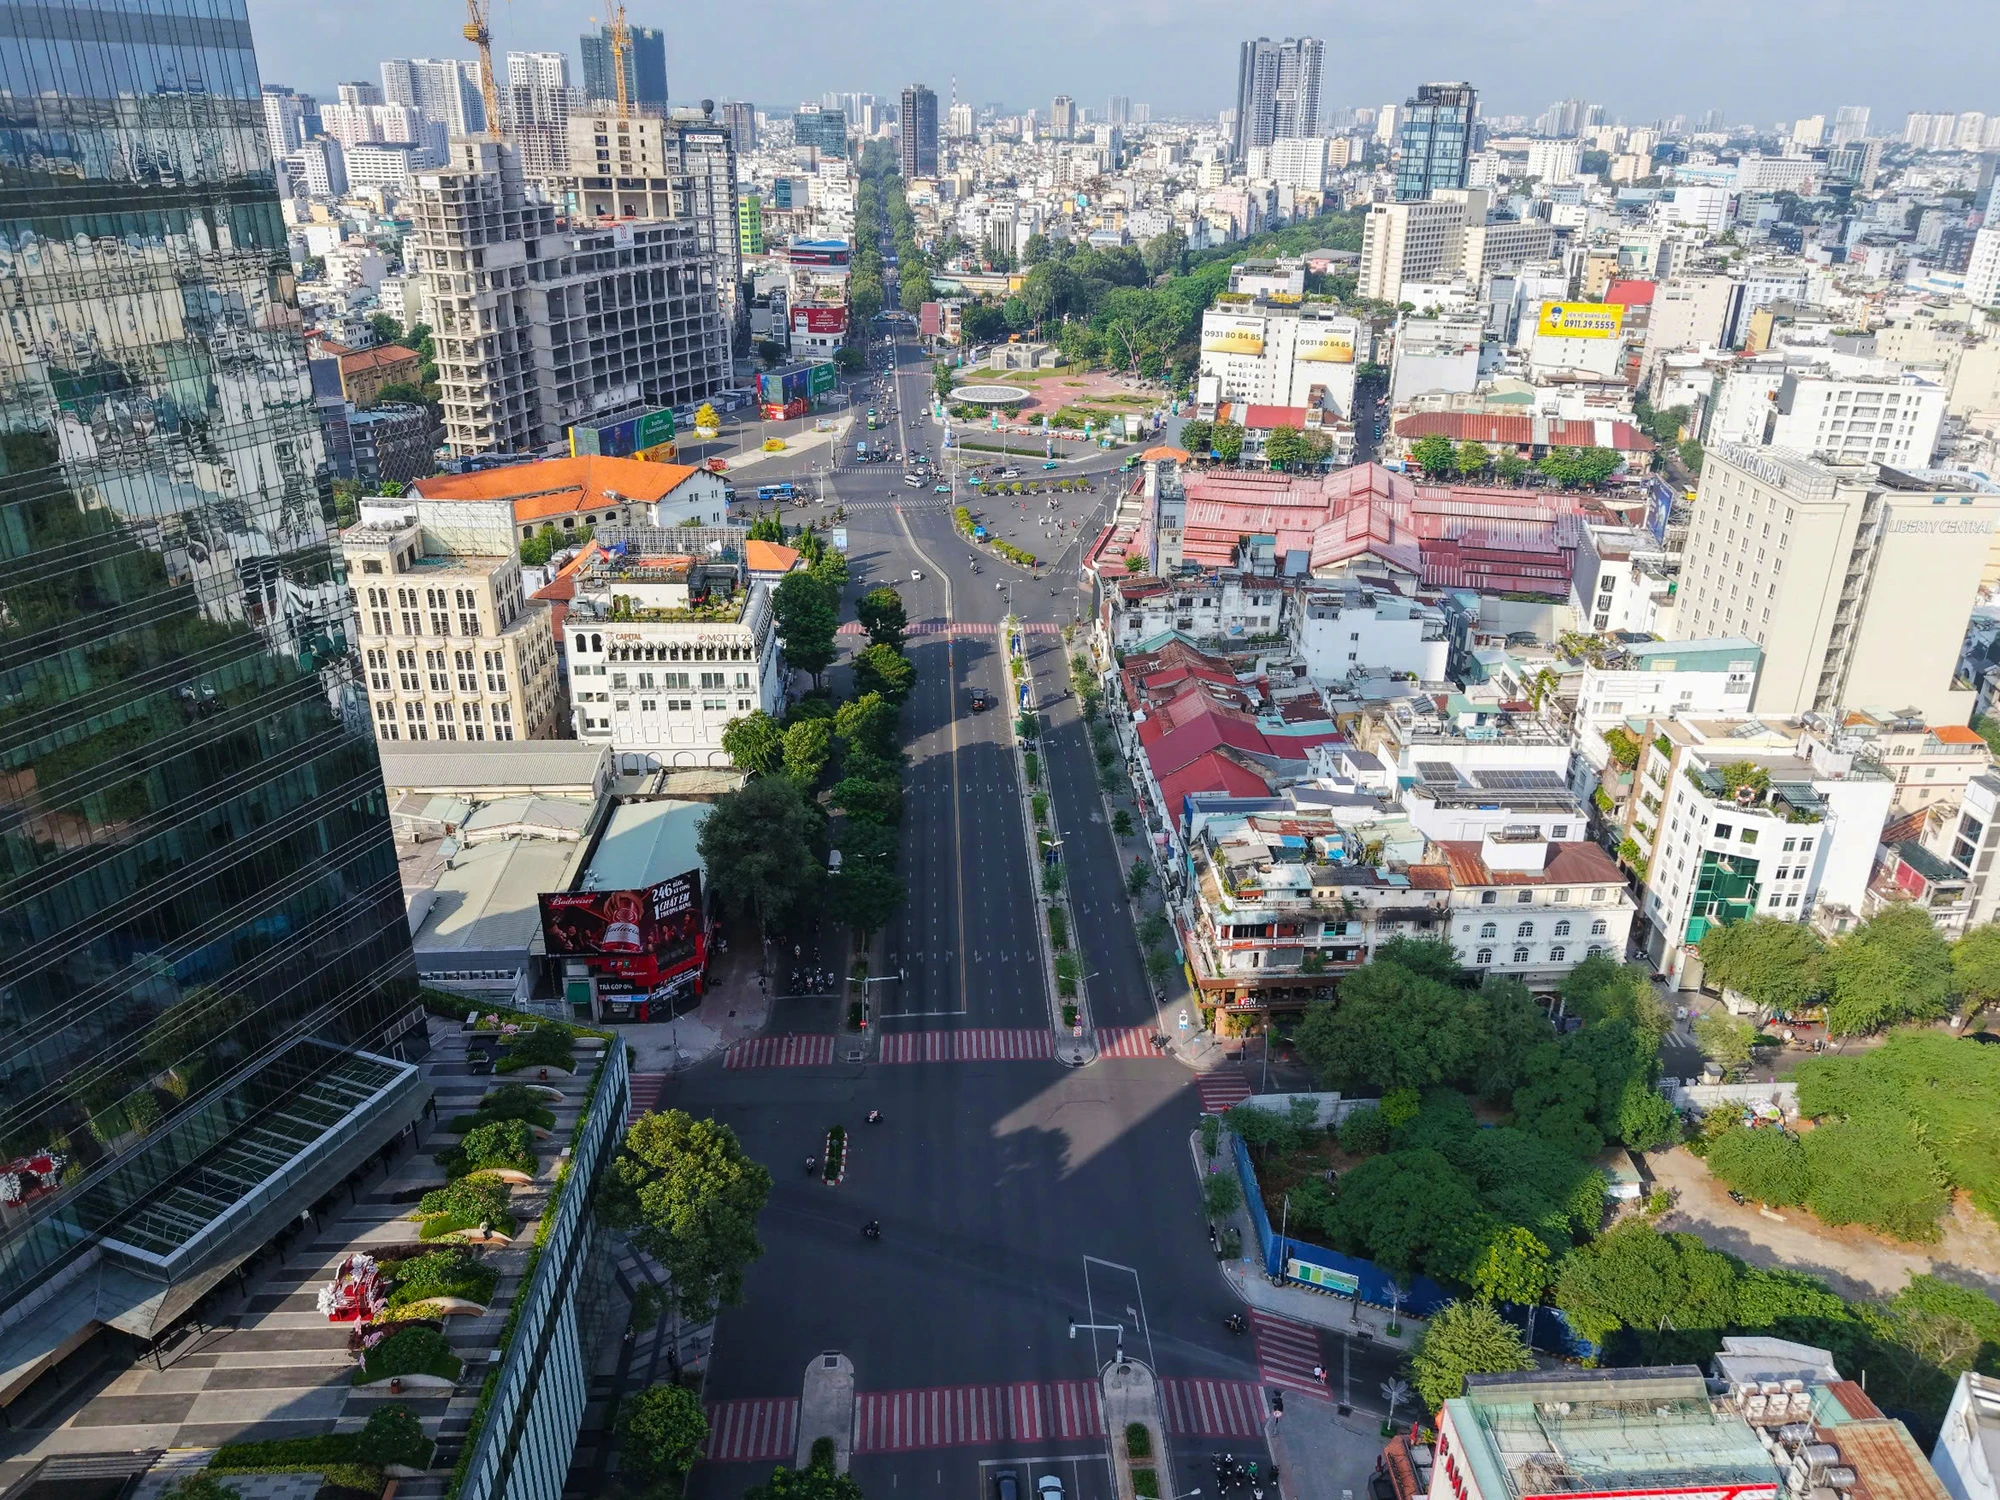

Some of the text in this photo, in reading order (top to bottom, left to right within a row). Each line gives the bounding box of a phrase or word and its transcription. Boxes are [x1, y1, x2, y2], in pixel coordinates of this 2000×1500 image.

[1564, 320, 1615, 329] 0911.39.5555
[1204, 330, 1261, 341] 0931 80 84 85
[1719, 439, 1785, 487] LIBERTY CENTRAL
[1888, 519, 1993, 534] LIBERTY CENTRAL
[741, 634, 752, 642] 23
[652, 883, 673, 902] 246
[551, 897, 594, 906] Budweiser
[654, 904, 660, 920] 1
